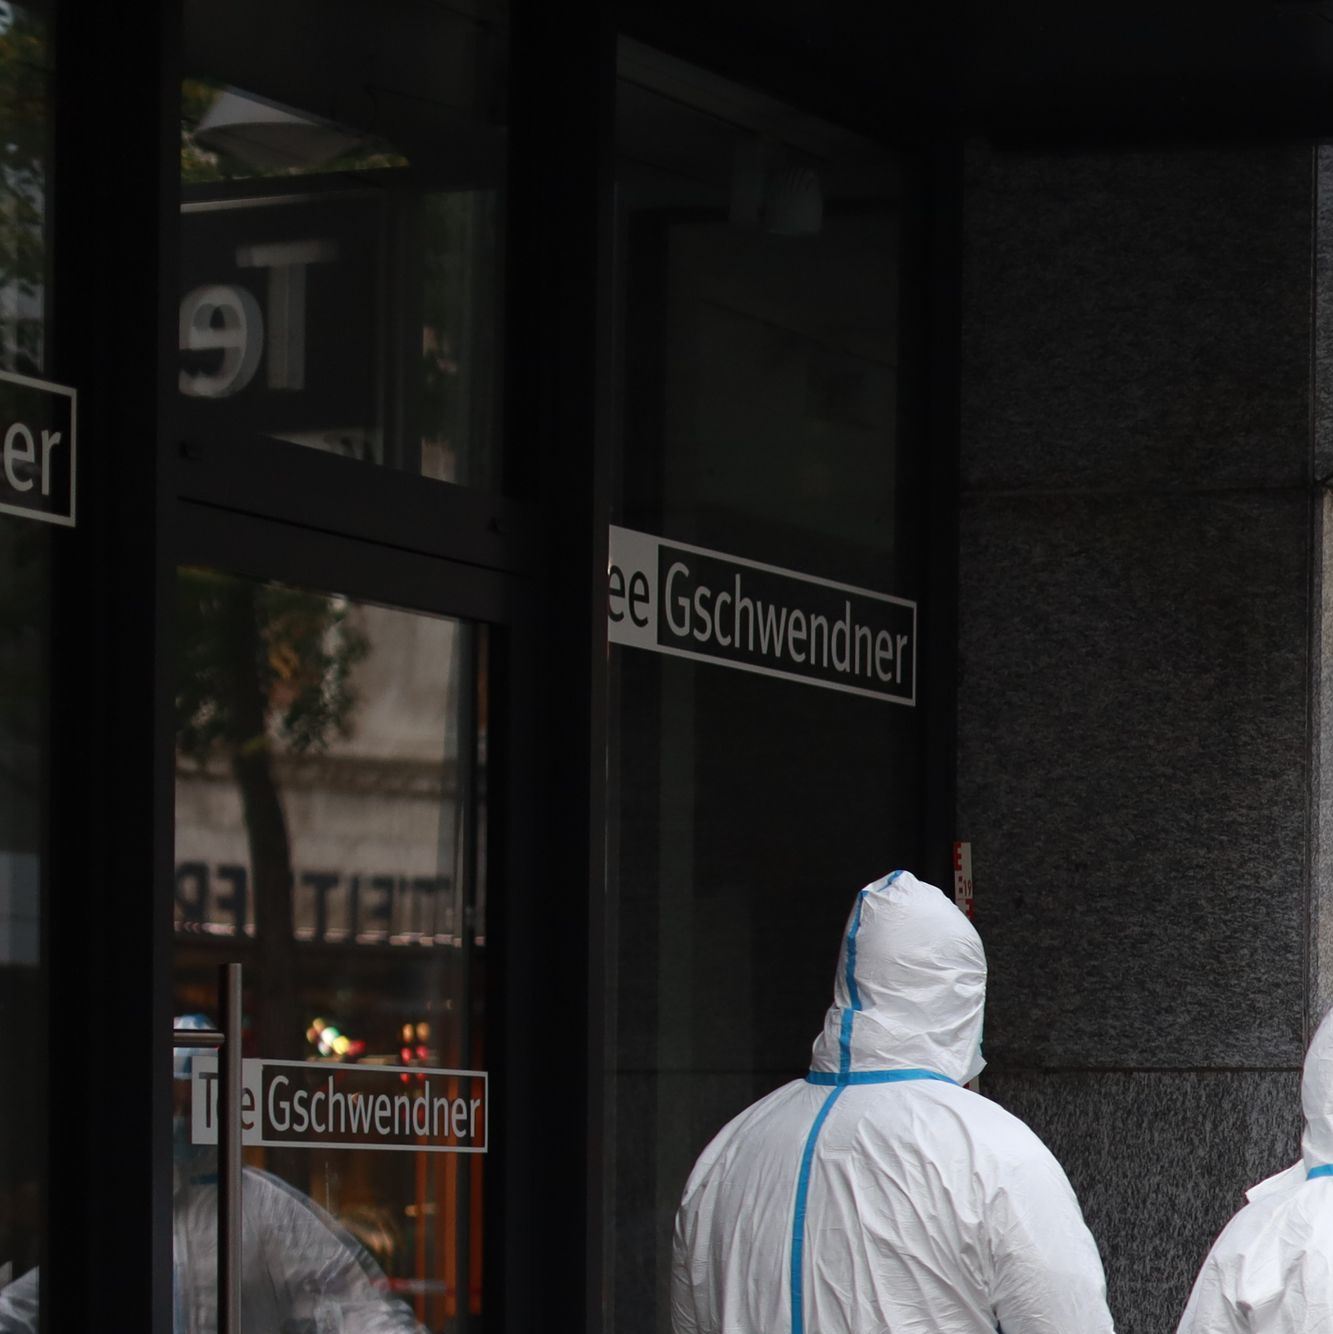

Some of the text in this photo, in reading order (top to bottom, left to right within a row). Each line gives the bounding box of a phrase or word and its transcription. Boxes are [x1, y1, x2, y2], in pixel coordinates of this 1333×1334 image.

[664, 561, 908, 684] Gschwendner
[198, 1070, 481, 1137] Te Gschwendner
